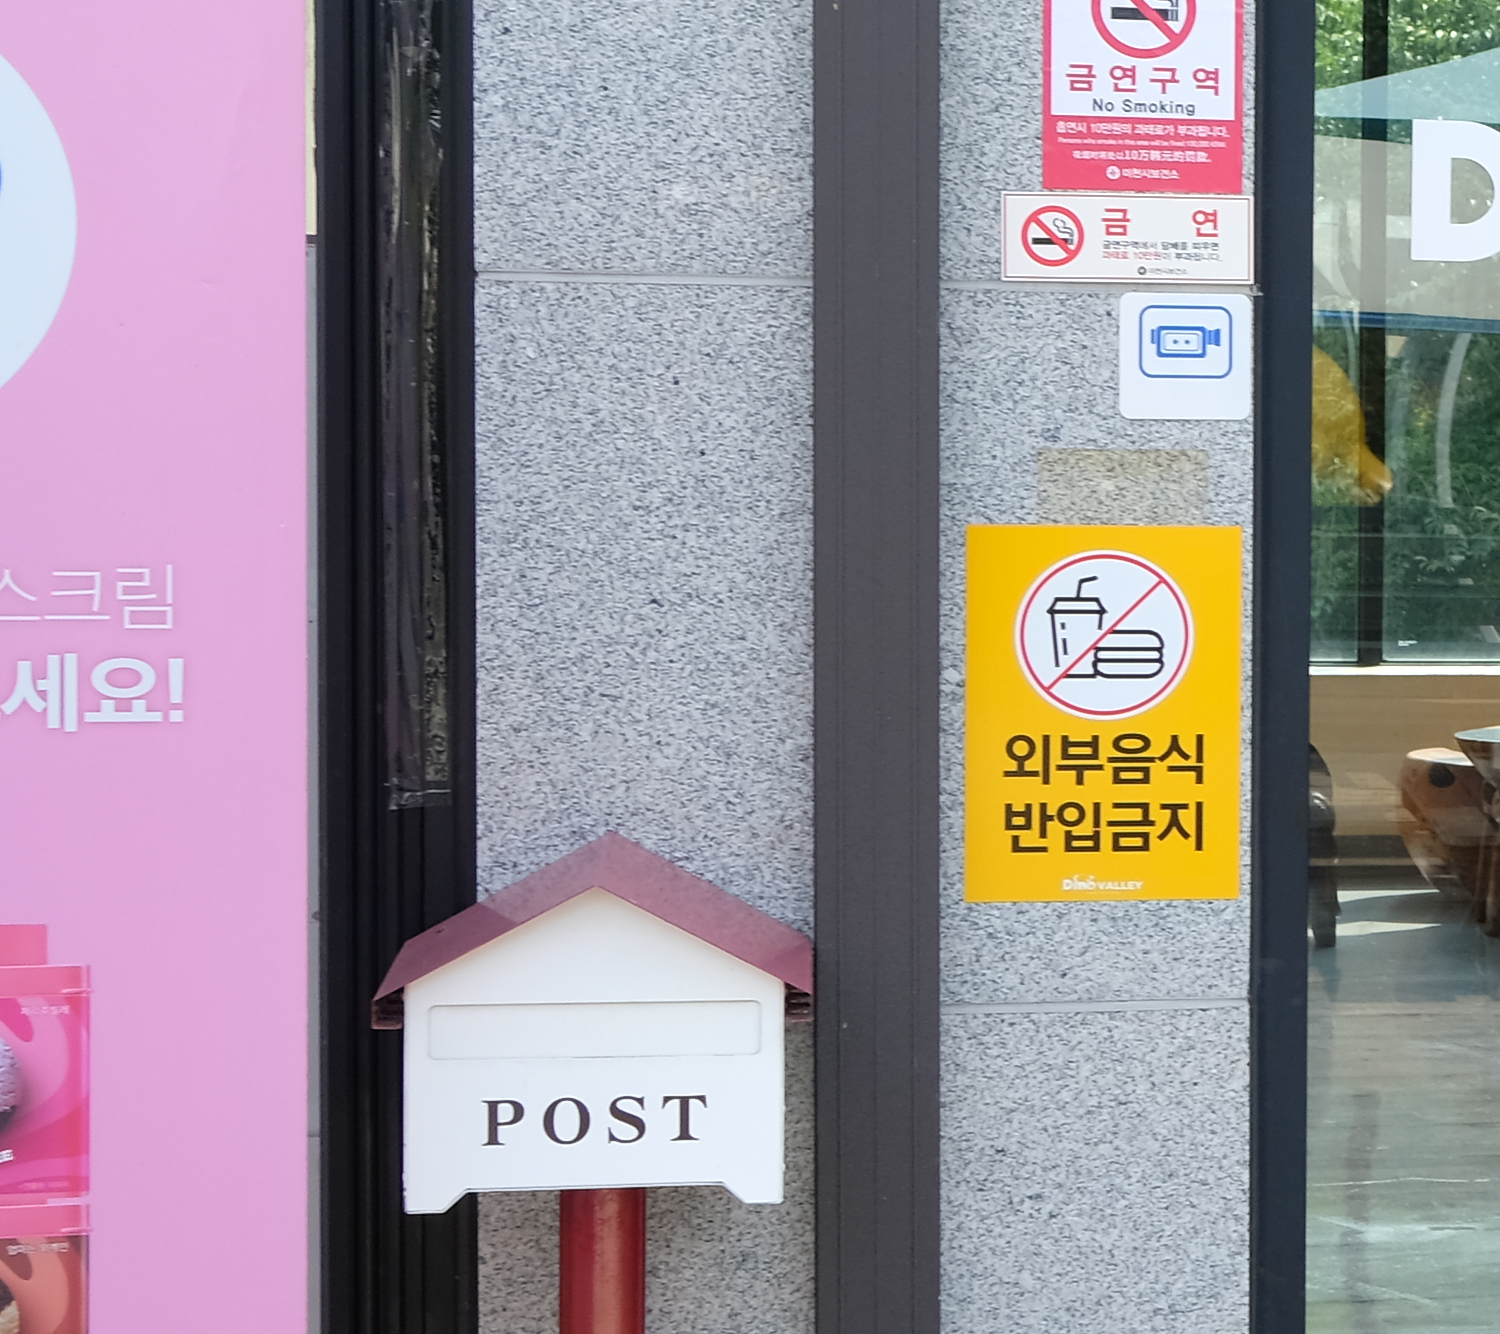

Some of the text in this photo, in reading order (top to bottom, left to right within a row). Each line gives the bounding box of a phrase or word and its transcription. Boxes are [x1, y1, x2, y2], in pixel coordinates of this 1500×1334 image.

[1066, 64, 1219, 96] 금연구역
[1093, 98, 1195, 116] No Smoking
[1, 652, 183, 731] 세요!
[1004, 733, 1204, 785] 외부음식
[1005, 802, 1203, 853] 반입금지
[1098, 880, 1143, 890] VALLEY
[482, 1095, 707, 1146] POST
